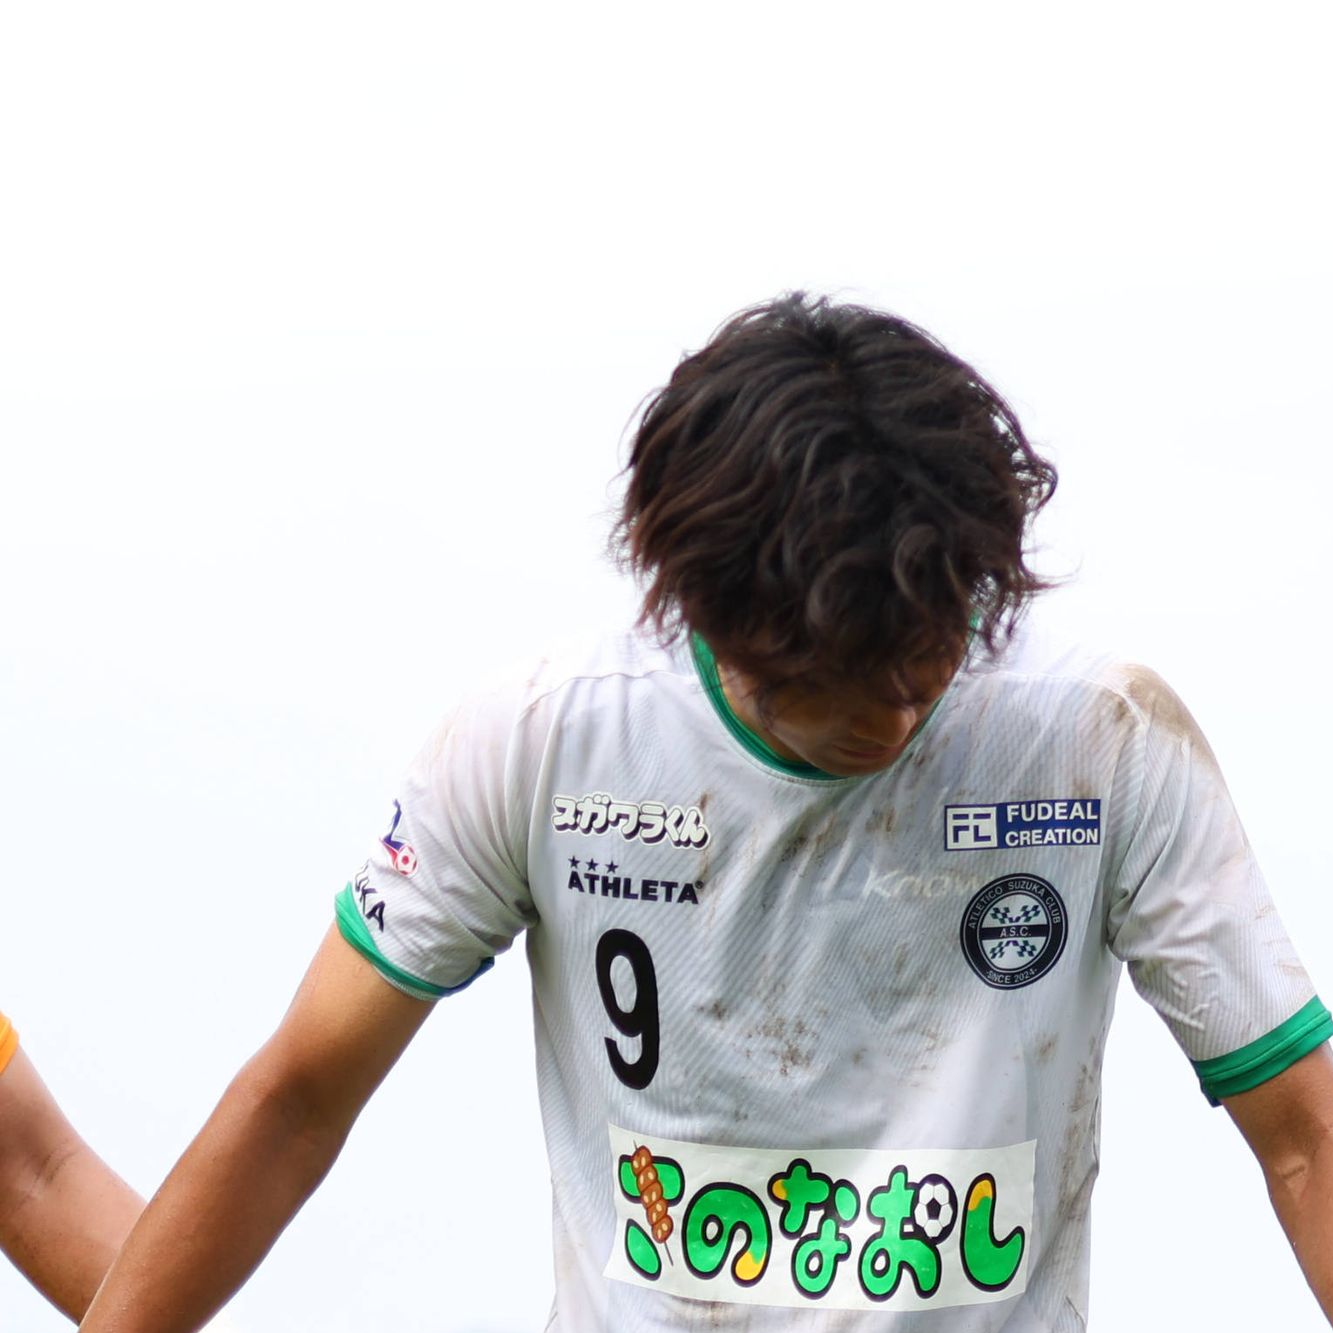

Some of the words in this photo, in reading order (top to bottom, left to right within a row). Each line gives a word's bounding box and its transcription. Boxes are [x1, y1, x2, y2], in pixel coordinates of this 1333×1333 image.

[552, 792, 711, 849] スガワラくん
[1007, 802, 1098, 823] FUDEAL
[1005, 828, 1098, 847] CREATION
[969, 887, 1003, 929] ATLETICO
[1008, 881, 1045, 897] SUZUKA
[1045, 898, 1062, 924] CLUB
[595, 928, 659, 1090] 9
